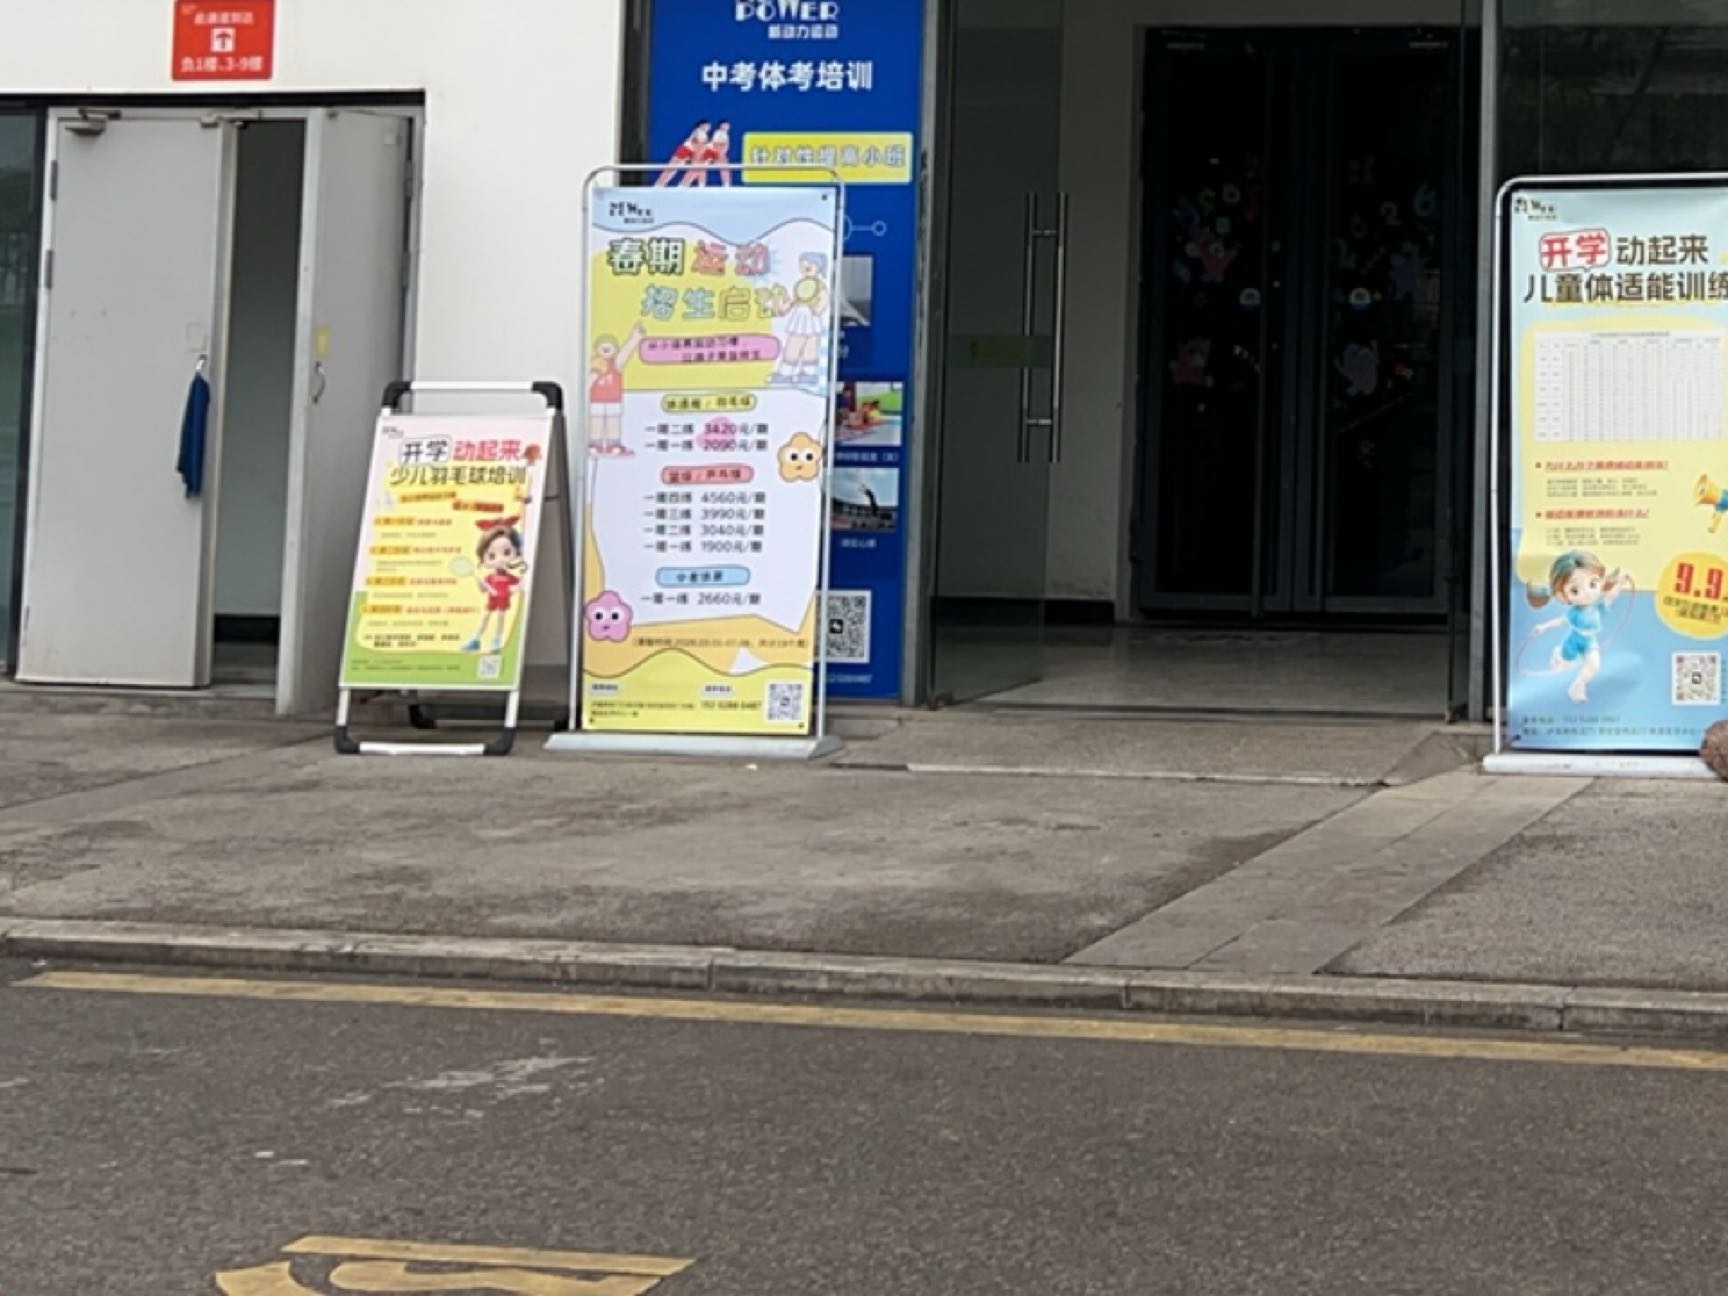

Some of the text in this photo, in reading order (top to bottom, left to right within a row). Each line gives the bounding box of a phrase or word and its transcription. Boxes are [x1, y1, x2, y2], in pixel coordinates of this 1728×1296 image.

[702, 59, 873, 92] 中考体考培训
